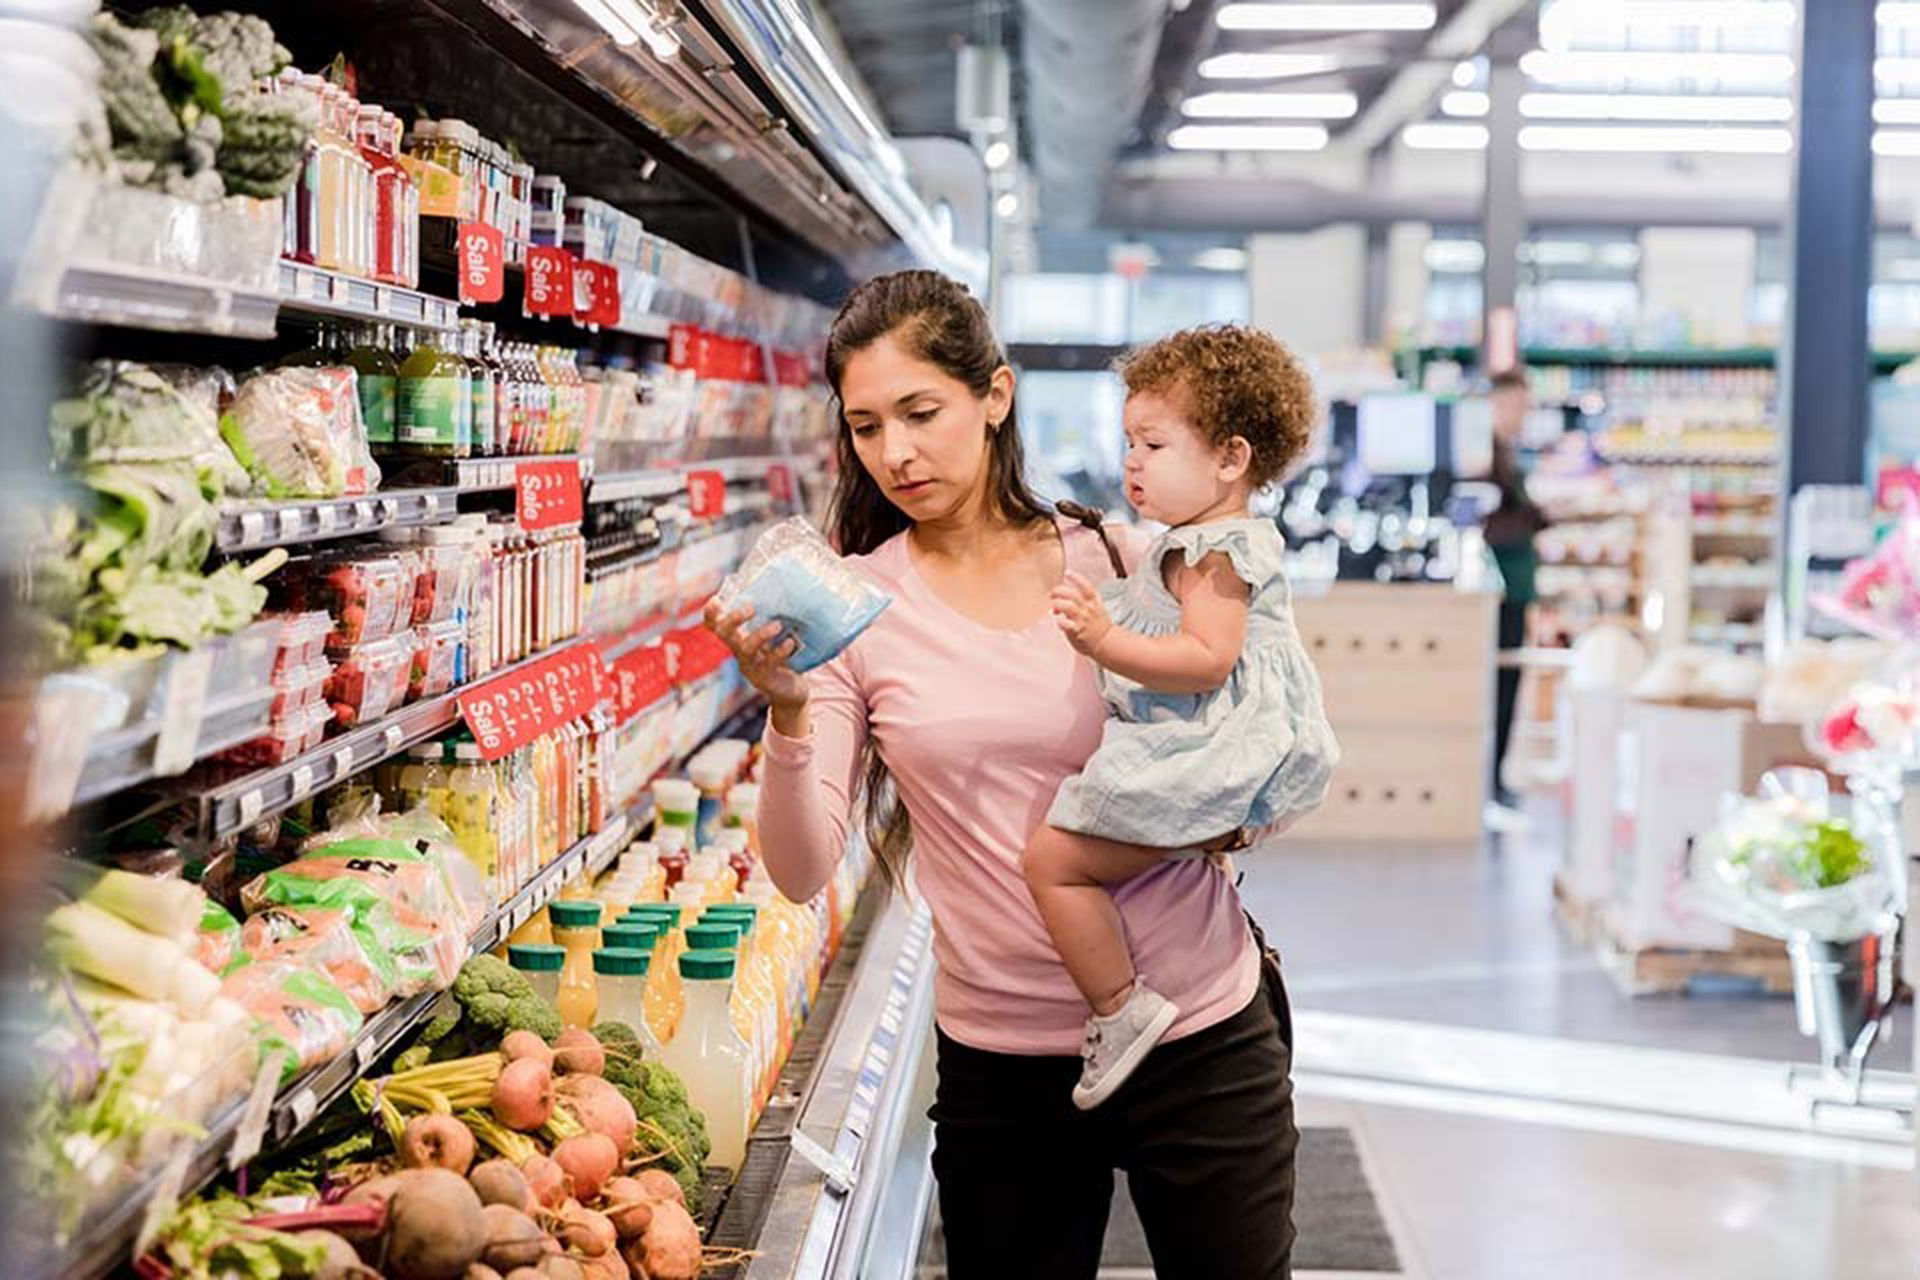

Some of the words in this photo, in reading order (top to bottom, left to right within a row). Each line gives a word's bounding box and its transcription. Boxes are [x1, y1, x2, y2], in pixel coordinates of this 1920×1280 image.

[466, 235, 491, 286] Sale
[531, 256, 553, 303] Sale
[521, 474, 543, 520] Sale
[469, 700, 502, 749] Sale
